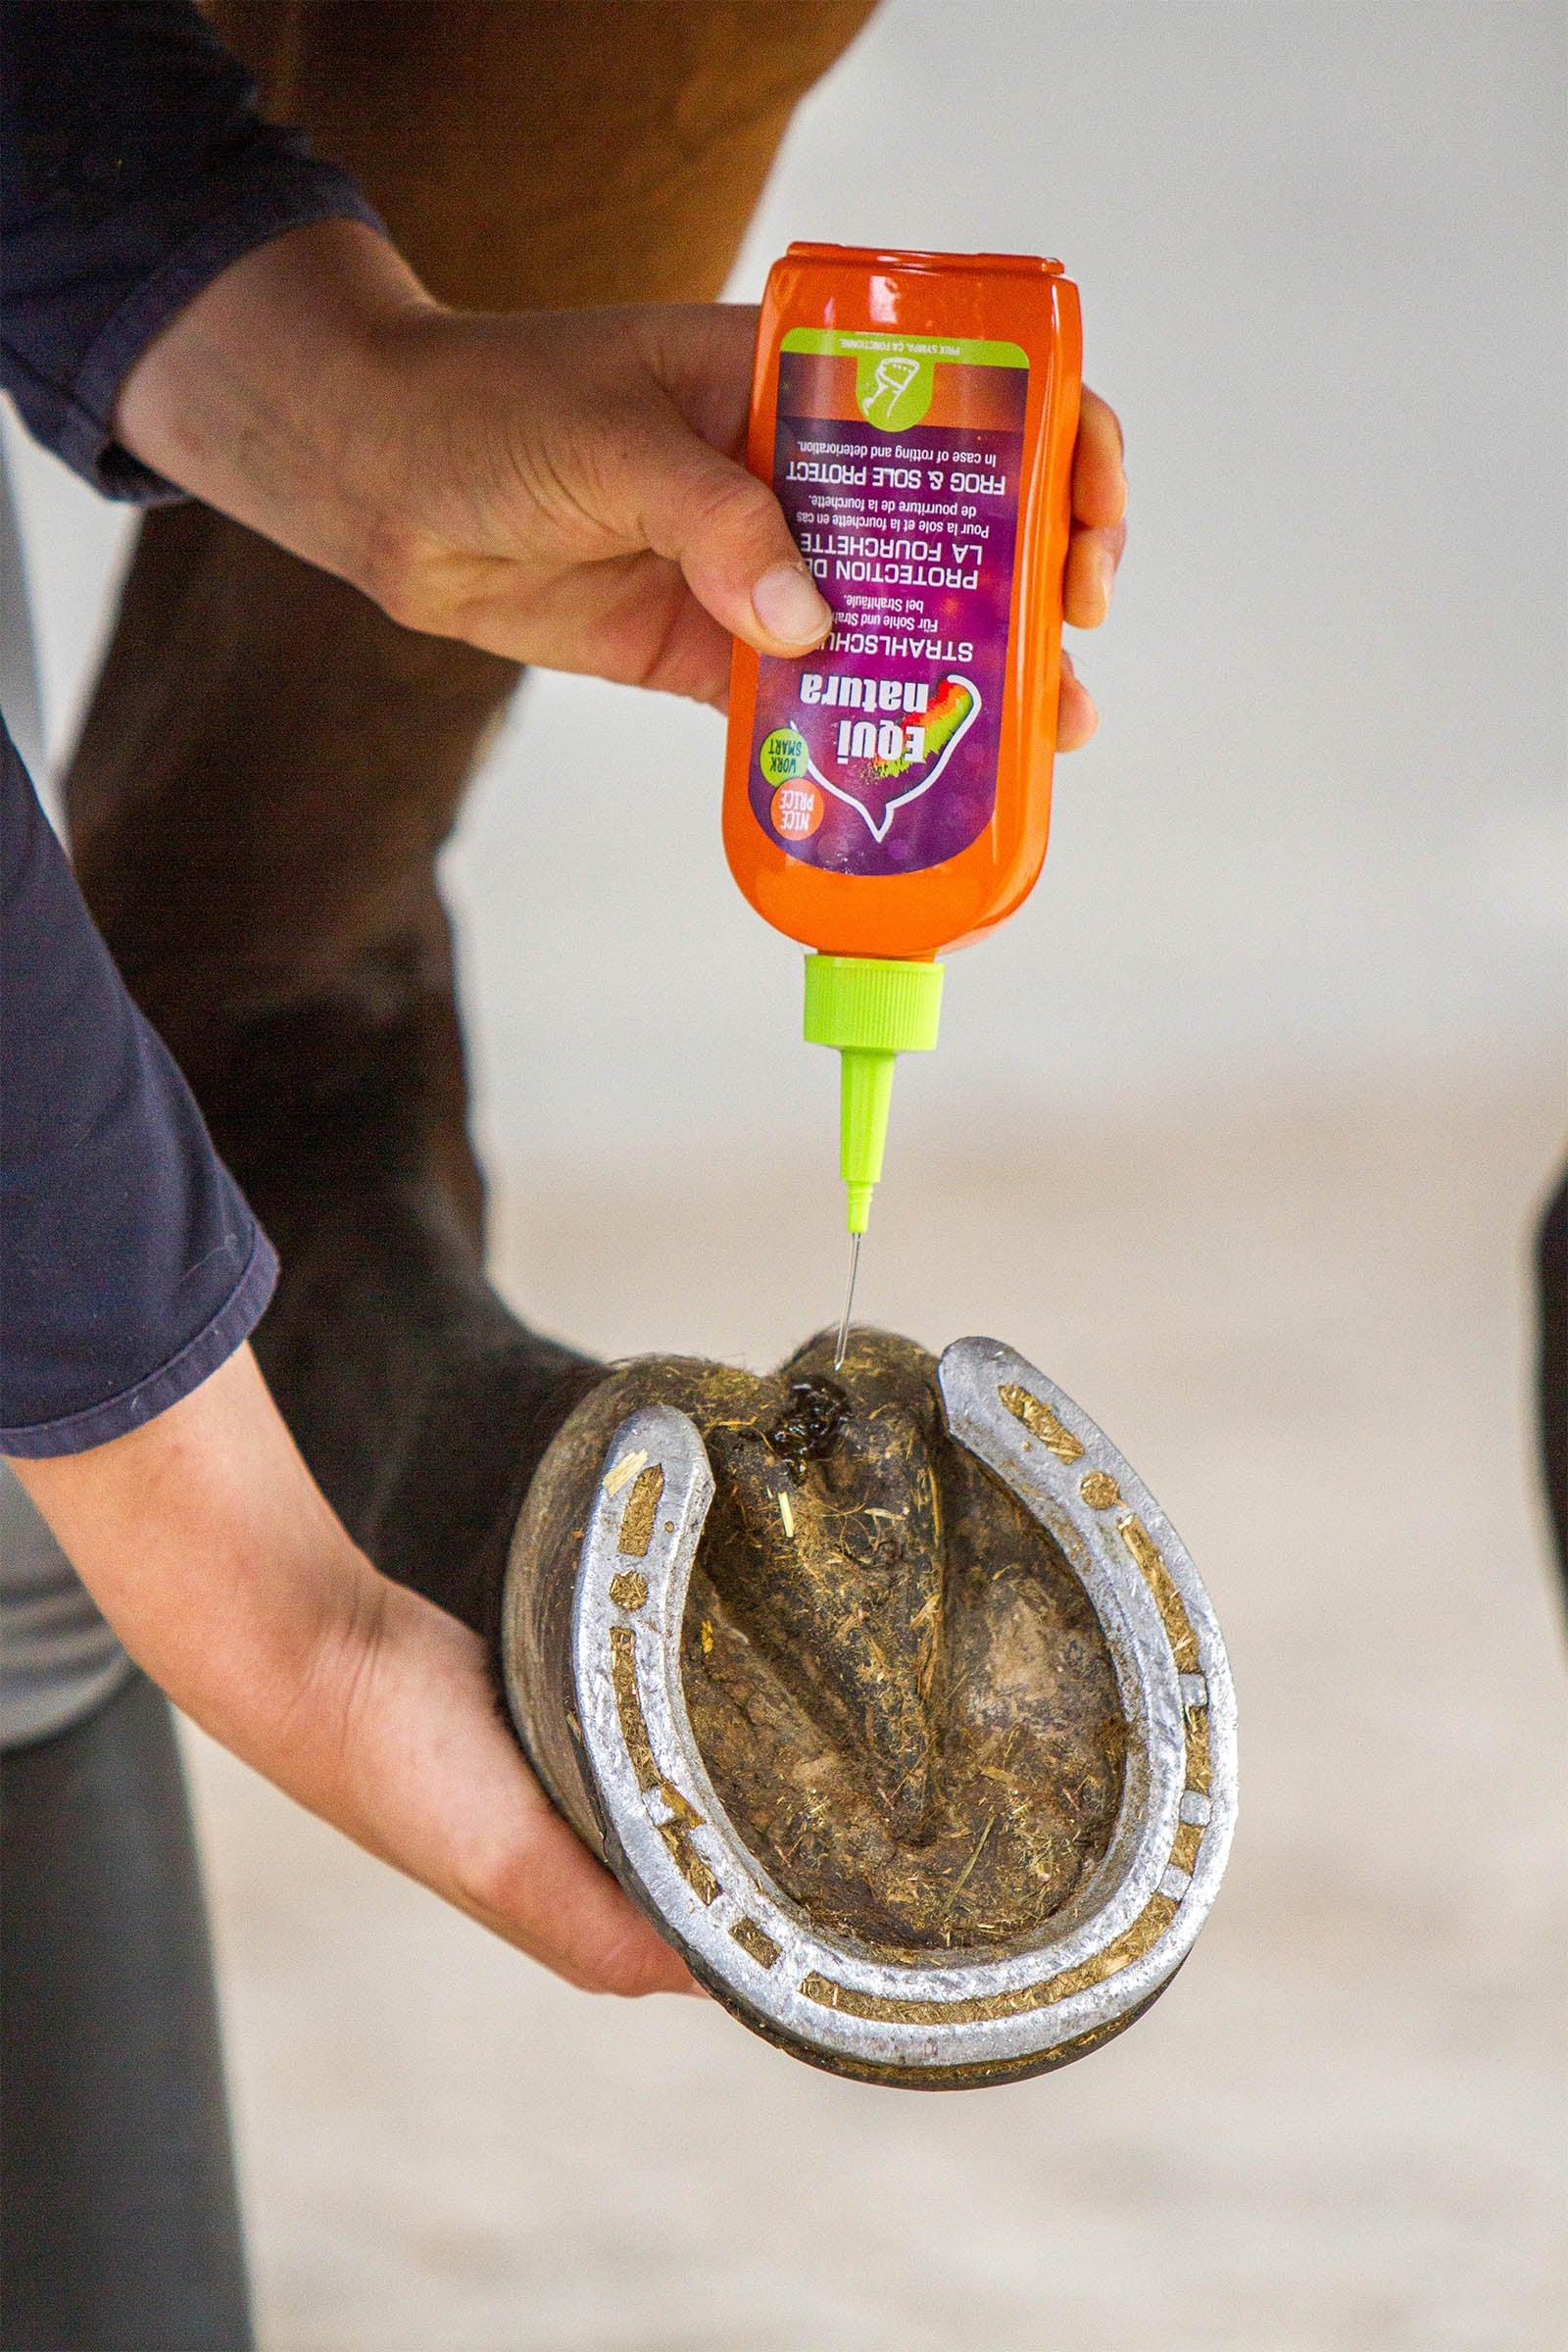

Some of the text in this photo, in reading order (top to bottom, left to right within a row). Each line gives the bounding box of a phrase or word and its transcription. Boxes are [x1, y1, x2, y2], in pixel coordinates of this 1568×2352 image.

[940, 345, 960, 356] PRIX
[797, 441, 996, 466] In case of rotting and deterioration.
[786, 461, 1005, 495] FROG & SOLE PROTECT
[808, 495, 976, 518] de pourriture de la fourchette.
[797, 512, 989, 538] Pour la sole et la fourchette en cas
[800, 532, 982, 564] LA FOURCHETTE
[836, 561, 978, 589] PROTECTION
[843, 594, 923, 612] bei Strahlfäule.
[860, 613, 881, 627] und
[883, 614, 914, 630] Sohle
[918, 618, 938, 632] Für
[815, 632, 973, 662] STRAHLSCHU
[800, 673, 929, 715] natura
[768, 738, 803, 757] SMART
[768, 757, 797, 773] WORK
[778, 789, 814, 809] PRICE
[779, 810, 809, 831] NICE
